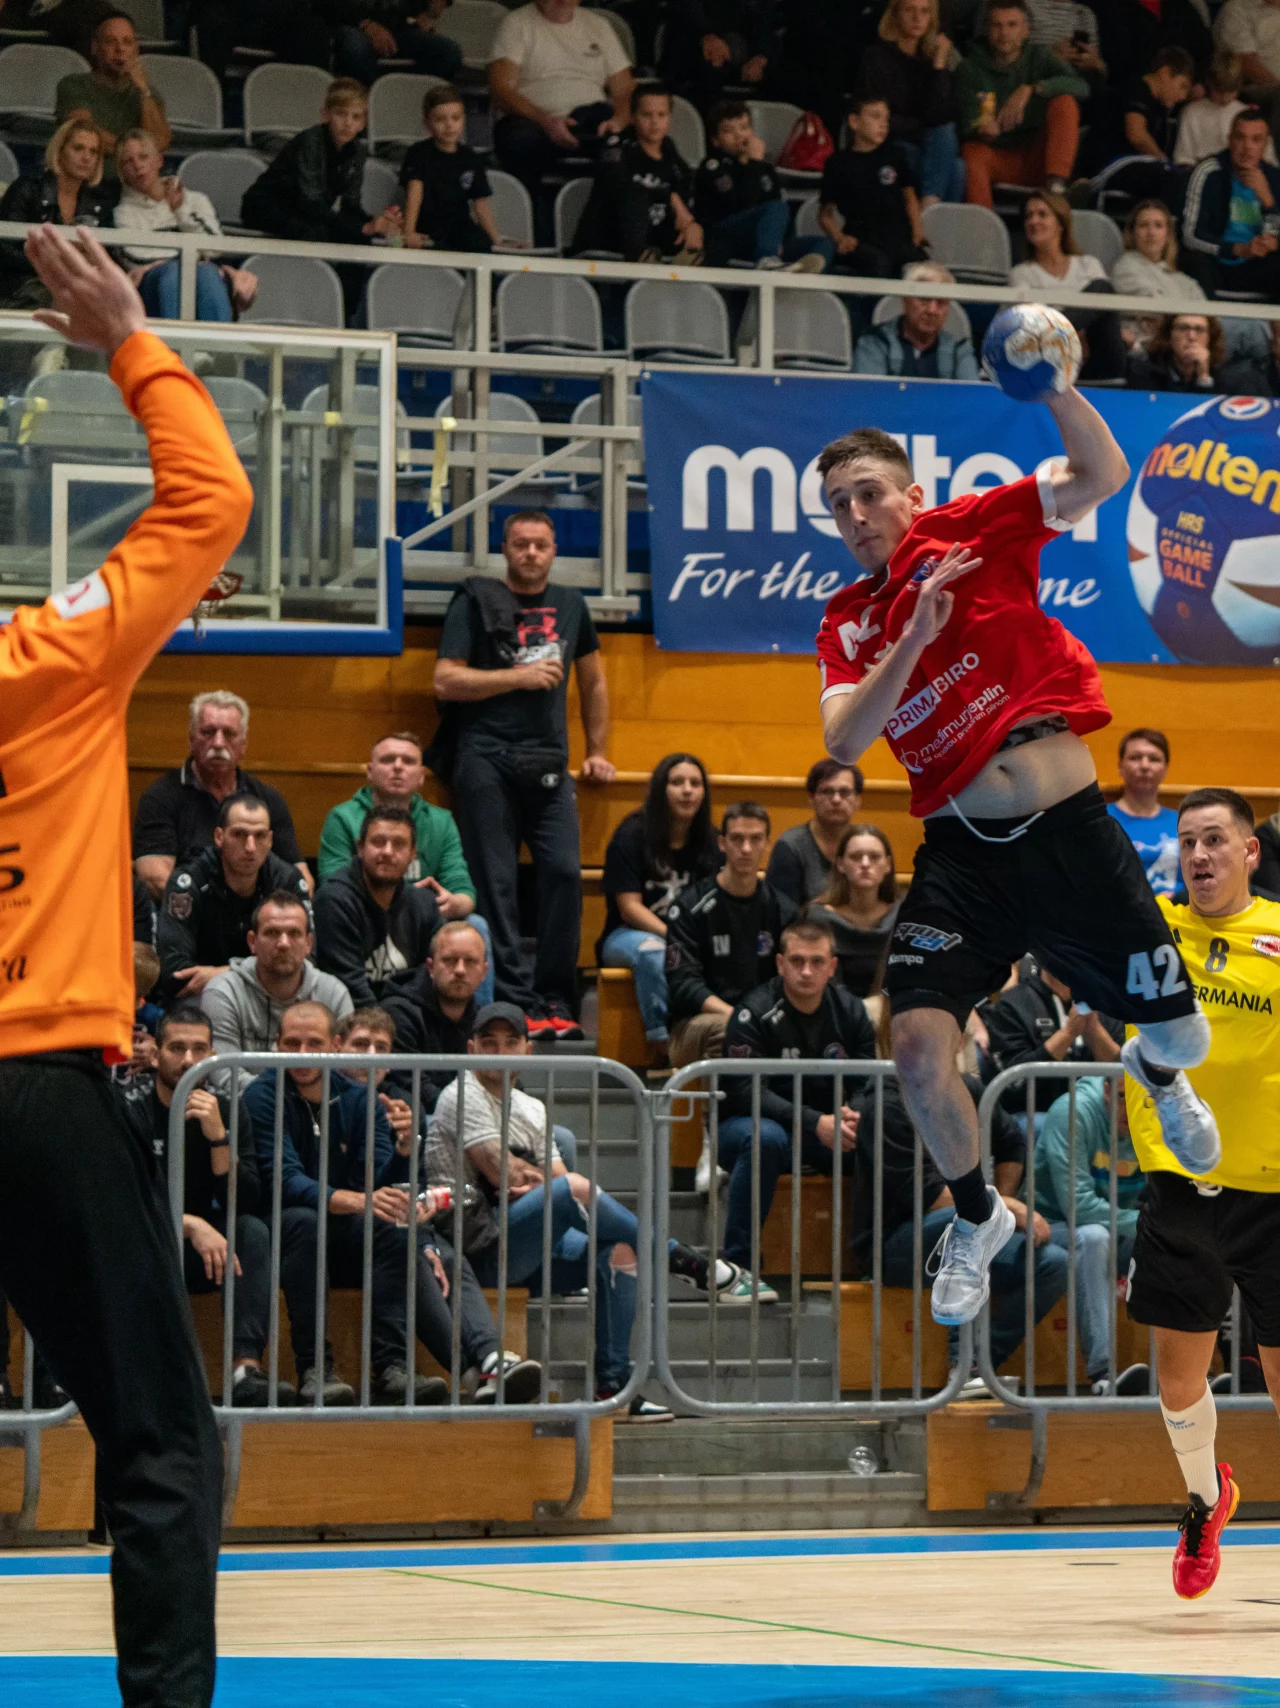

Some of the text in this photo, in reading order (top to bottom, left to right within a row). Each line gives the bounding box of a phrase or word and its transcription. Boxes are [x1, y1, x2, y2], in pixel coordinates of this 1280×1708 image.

[1176, 510, 1205, 534] HRS
[1160, 538, 1213, 572] GAME
[669, 552, 754, 601] For
[762, 551, 846, 601] the
[1163, 559, 1207, 589] BALL
[1126, 944, 1188, 1001] 42
[1205, 938, 1230, 973] 8
[1193, 984, 1273, 1015] ERMANIA
